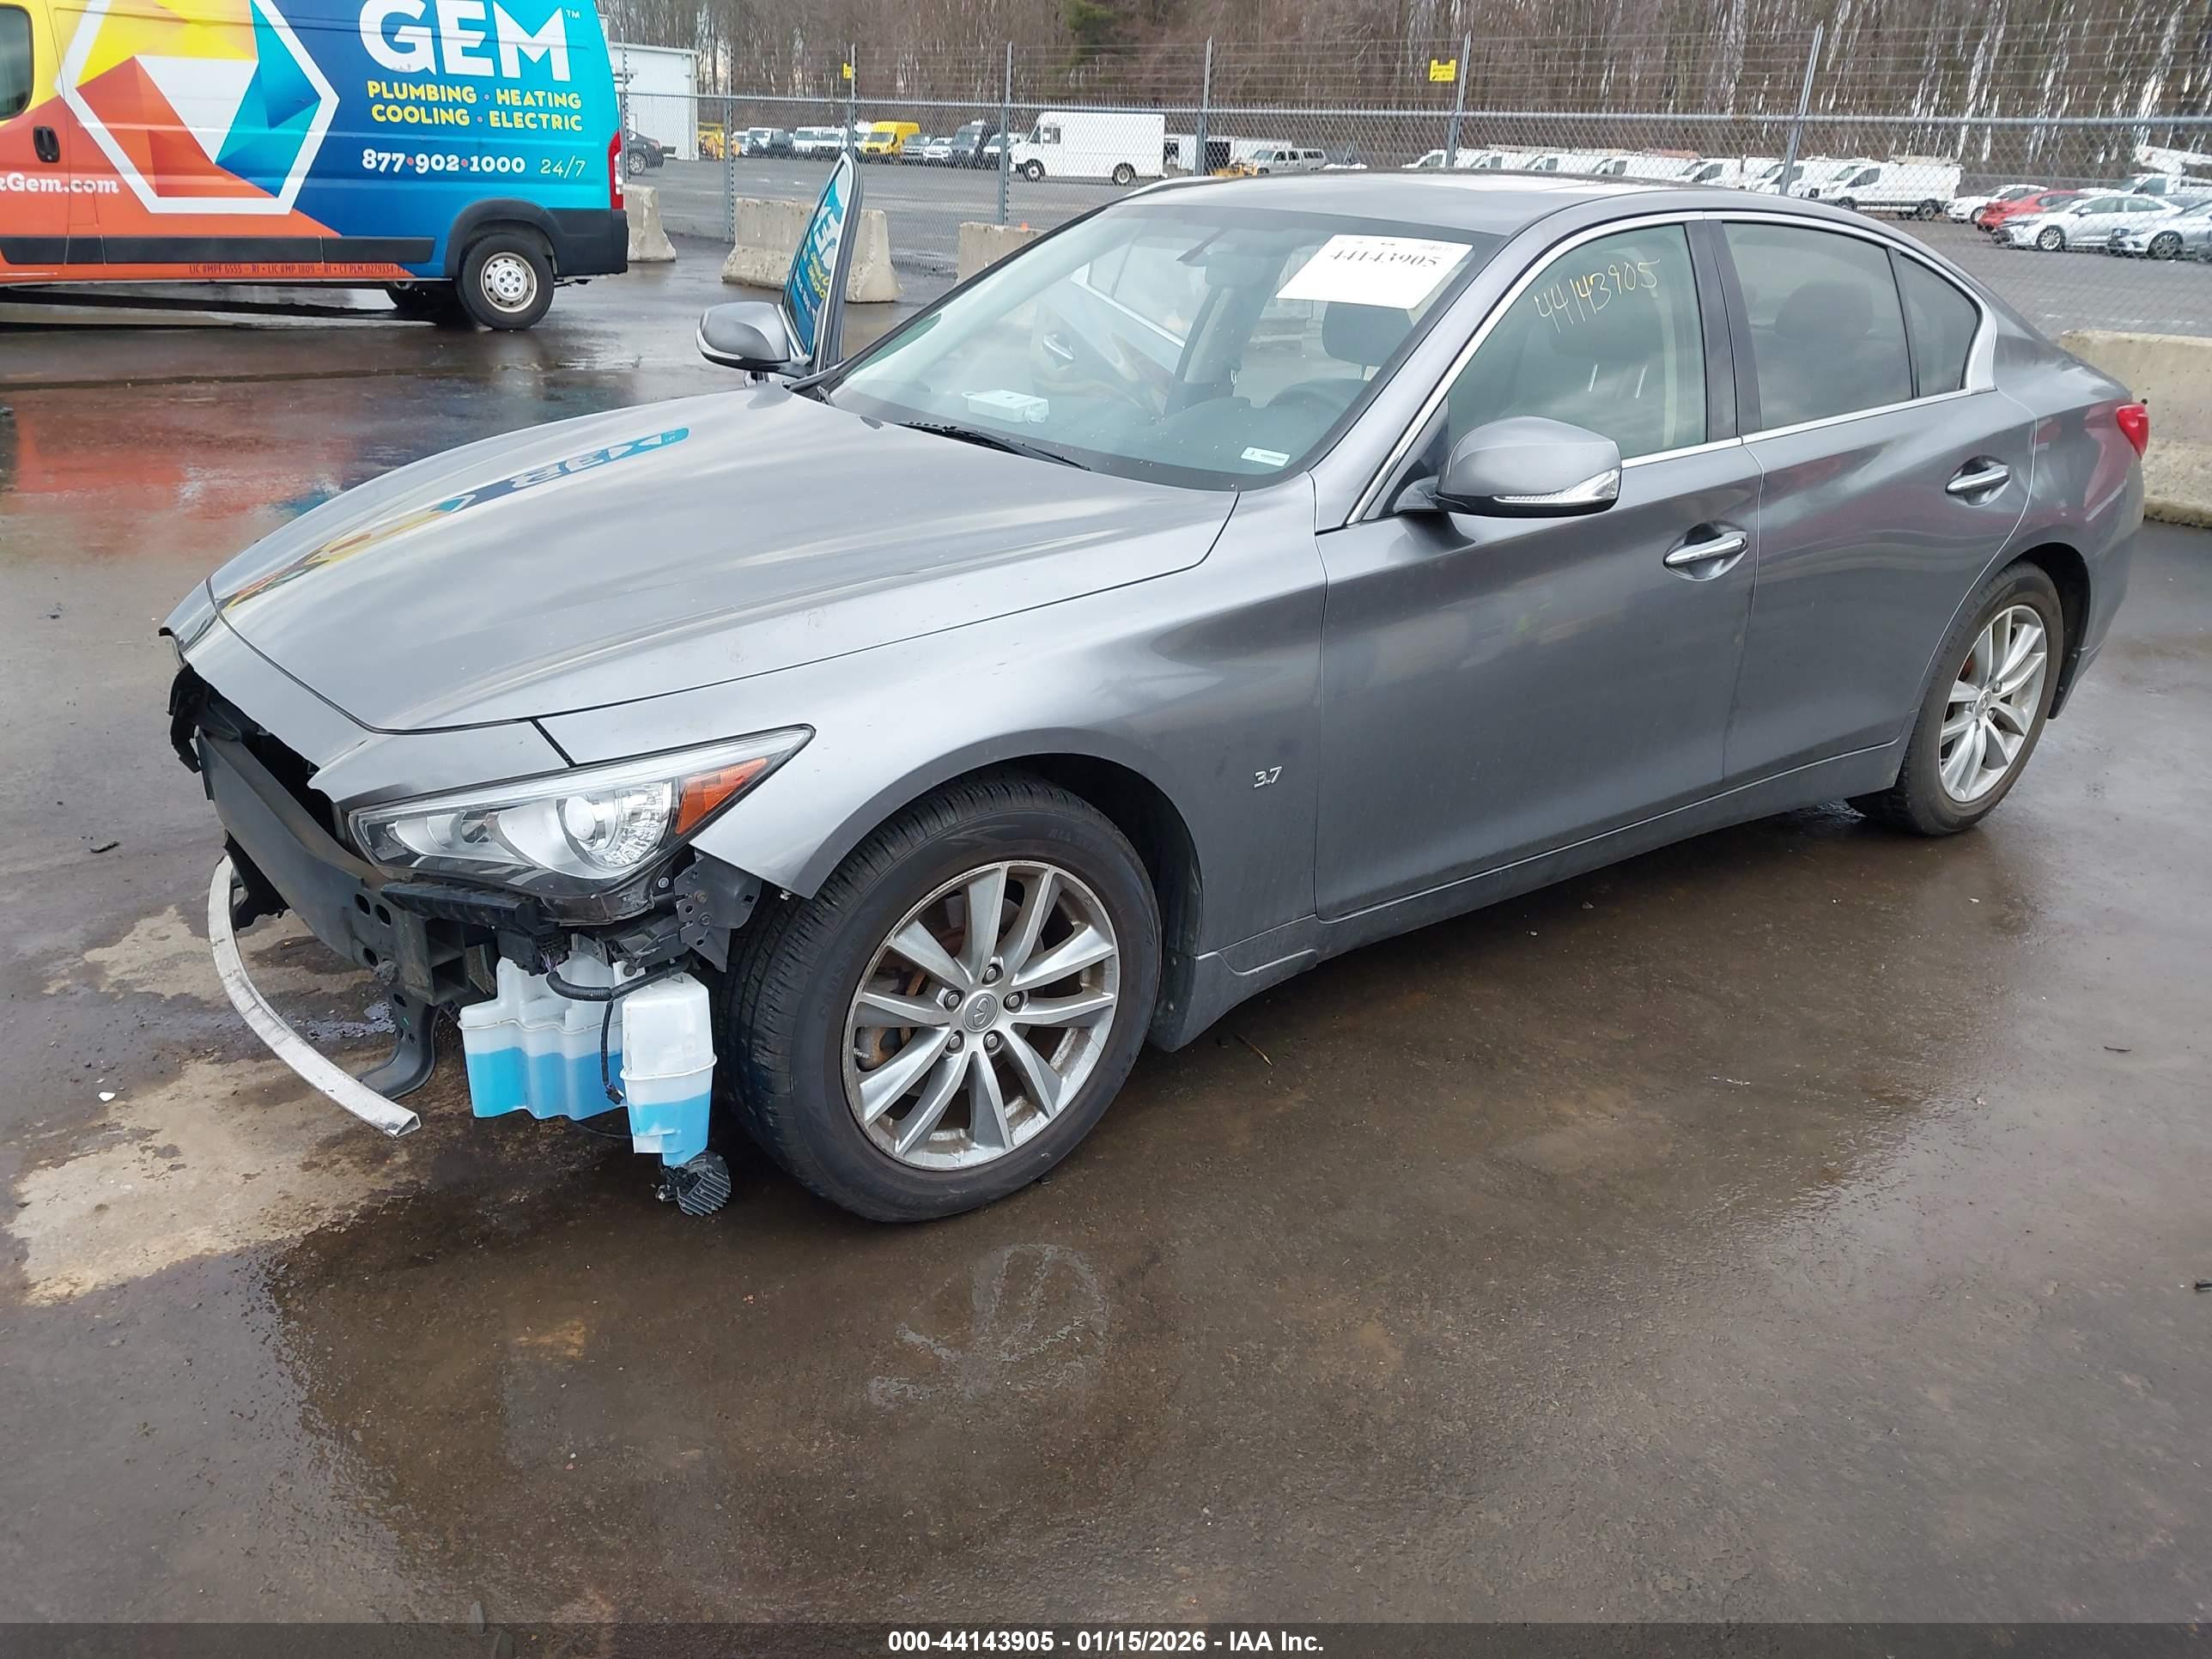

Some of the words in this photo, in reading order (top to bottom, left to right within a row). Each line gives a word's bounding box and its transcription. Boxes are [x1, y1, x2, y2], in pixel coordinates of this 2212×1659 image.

[359, 0, 571, 82] GEM
[367, 80, 477, 104] PLUMBING
[495, 88, 582, 109] HEATING
[371, 104, 471, 126] COOLING
[489, 110, 583, 131] ELECTRIC
[540, 155, 586, 179] 24/7
[1534, 258, 1661, 334] 44143905
[1254, 766, 1283, 788] 3.7
